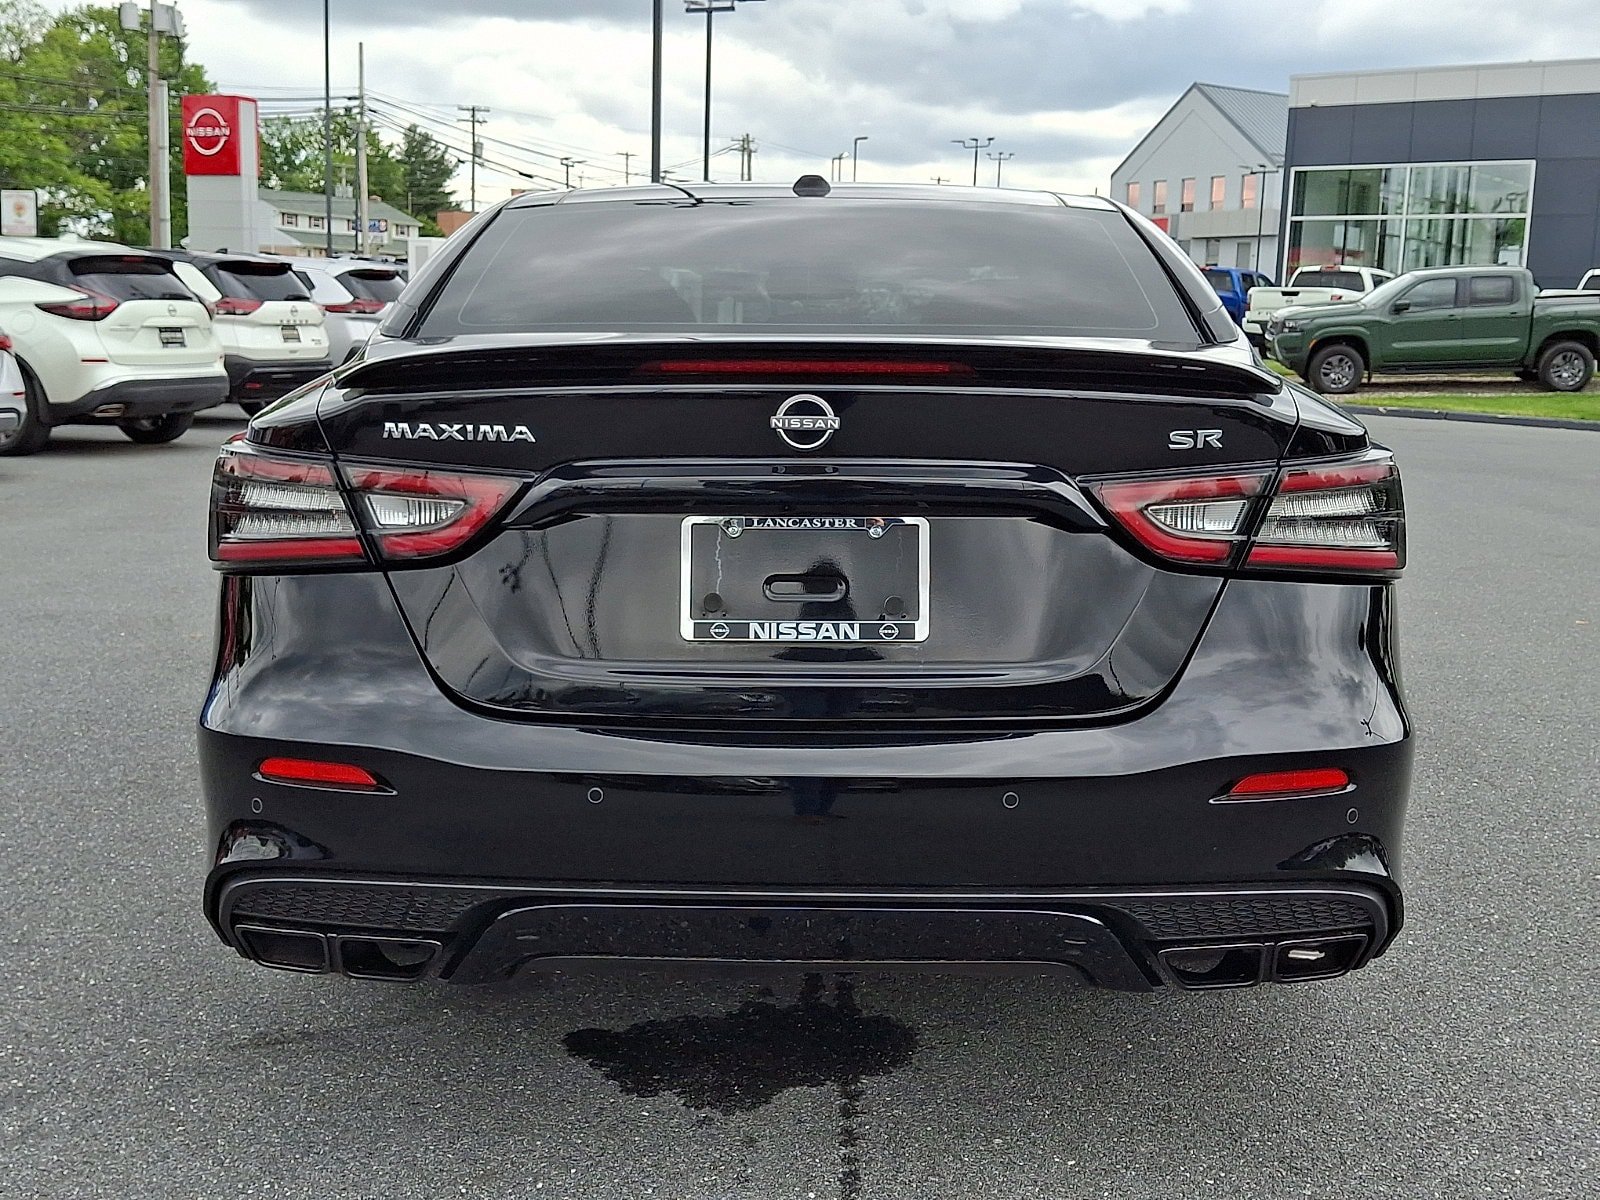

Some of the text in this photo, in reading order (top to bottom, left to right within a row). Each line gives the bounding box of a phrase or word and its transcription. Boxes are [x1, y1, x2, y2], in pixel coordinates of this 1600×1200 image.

[186, 126, 231, 137] NISSAN
[771, 418, 839, 429] NISSAN
[382, 421, 536, 443] MAXIMA
[1168, 429, 1223, 450] SR
[752, 518, 858, 528] LANCASTER
[749, 622, 860, 640] NISSAN
